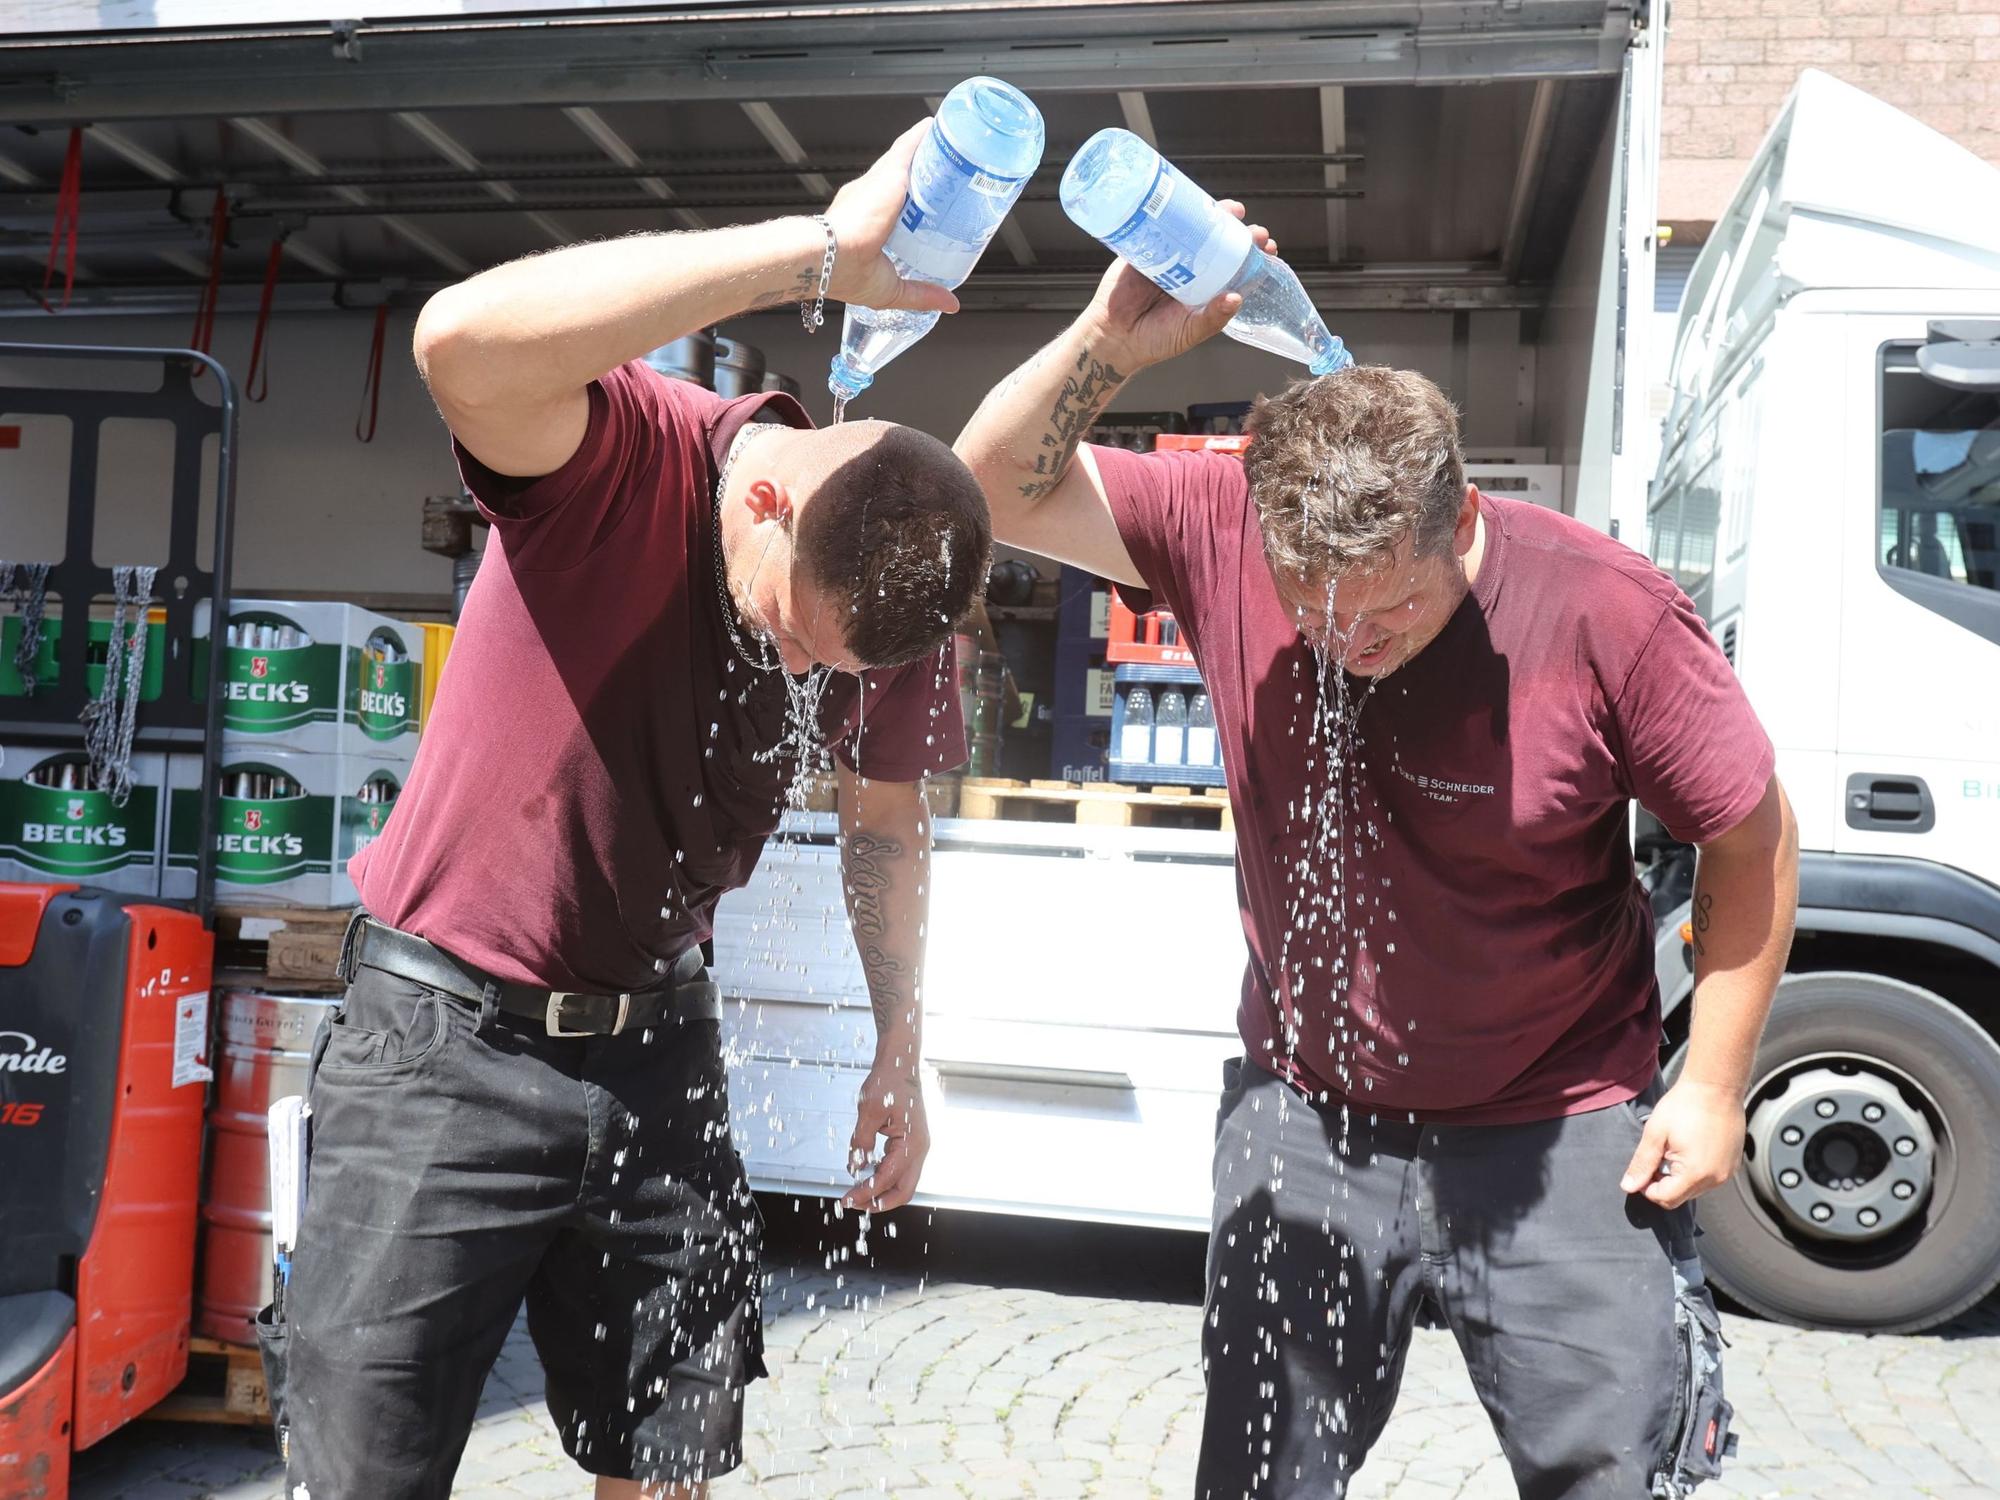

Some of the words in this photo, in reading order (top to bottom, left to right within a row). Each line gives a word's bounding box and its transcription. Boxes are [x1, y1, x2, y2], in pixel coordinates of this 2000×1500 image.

[223, 680, 310, 703] ECK'S
[360, 689, 405, 718] BECK'S
[1062, 764, 1104, 782] Gaffel
[1428, 791, 1454, 803] TEAM
[22, 822, 127, 847] BECK'S
[0, 1031, 67, 1075] nde
